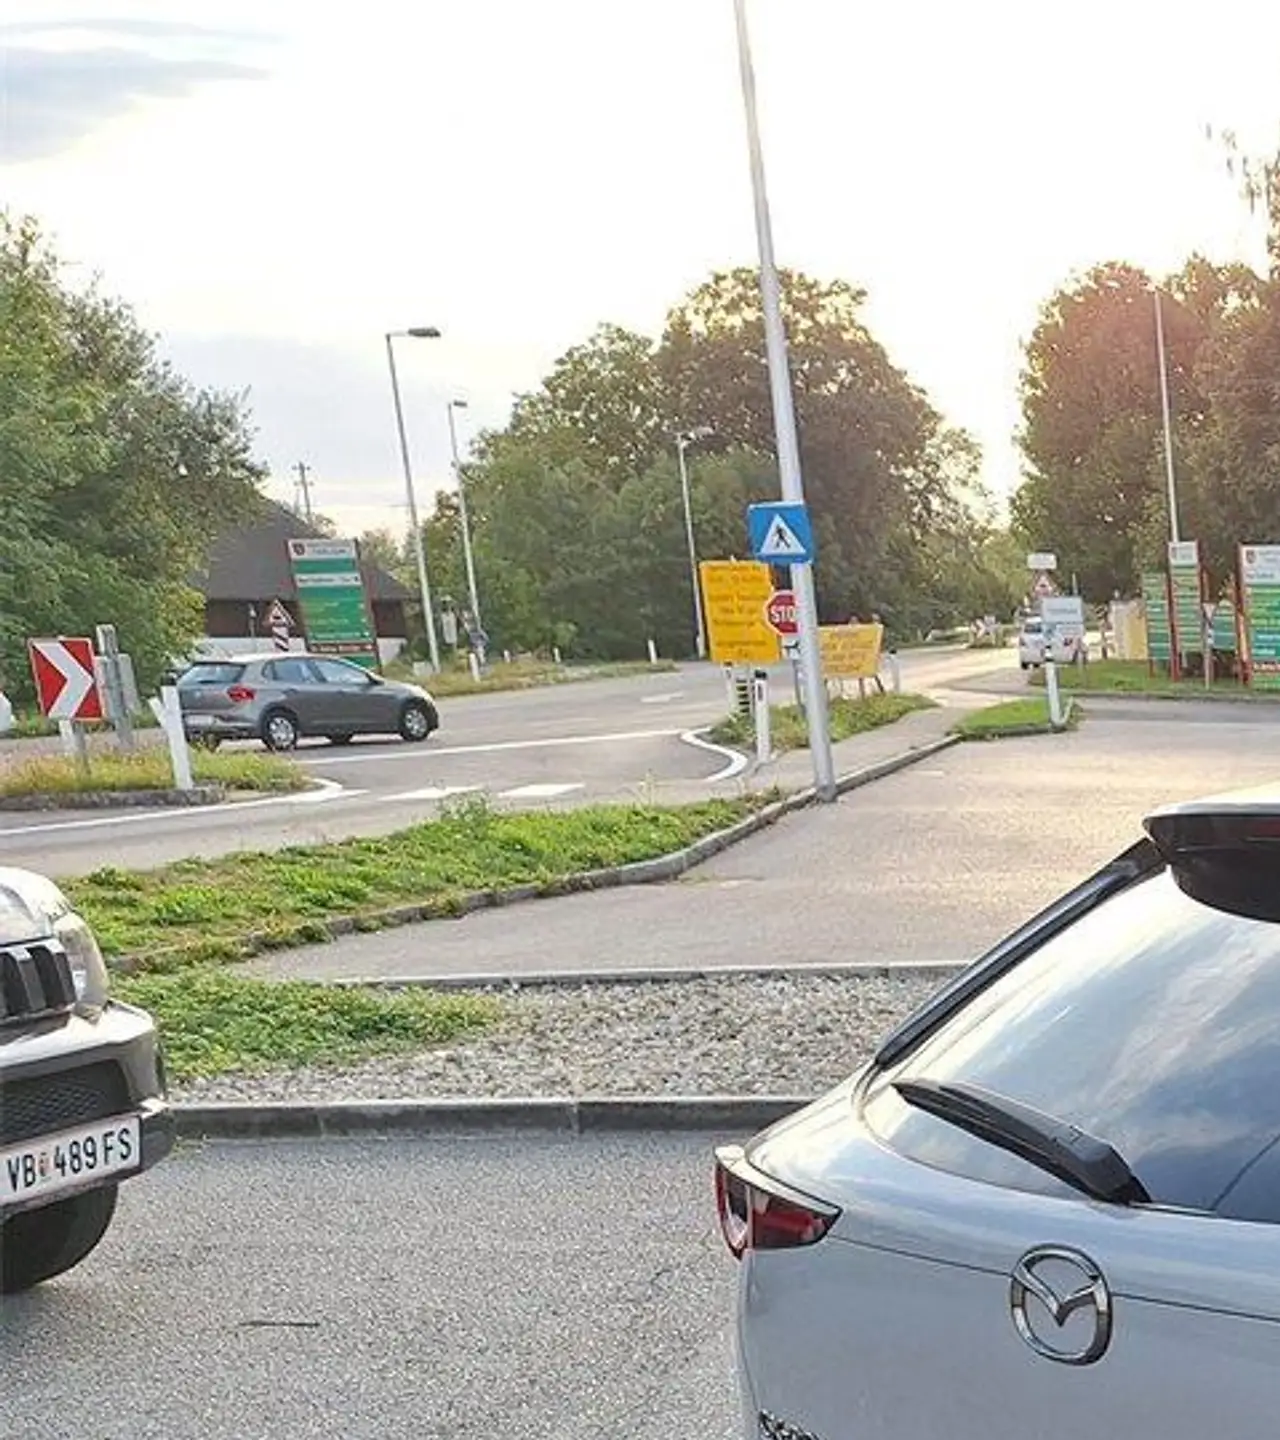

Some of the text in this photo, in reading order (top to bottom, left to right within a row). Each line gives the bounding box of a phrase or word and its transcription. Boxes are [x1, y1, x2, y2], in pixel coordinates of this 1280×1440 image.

[770, 605, 797, 623] STO
[7, 1127, 132, 1193] VB 489 FS
